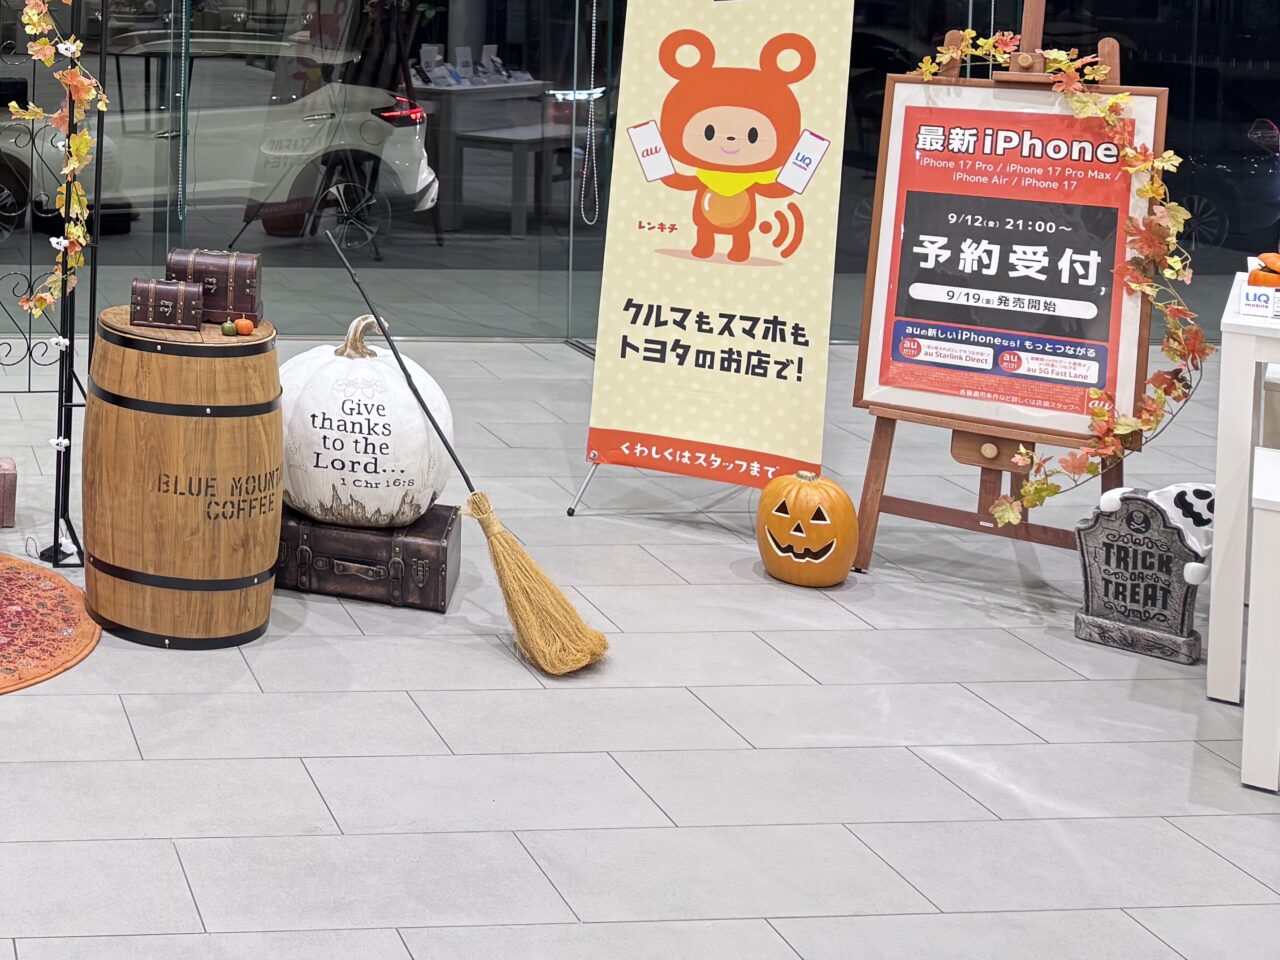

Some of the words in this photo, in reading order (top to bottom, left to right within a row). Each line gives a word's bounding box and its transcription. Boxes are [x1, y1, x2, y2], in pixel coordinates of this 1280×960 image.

[641, 145, 661, 158] au
[795, 152, 812, 168] UQ
[920, 157, 955, 168] iPhone
[959, 160, 972, 169] 17
[975, 161, 994, 172] Pro
[1006, 163, 1043, 175] iPhone
[1047, 166, 1062, 176] 17
[1065, 168, 1084, 179] Pro
[1088, 169, 1112, 180] Max
[953, 172, 989, 184] iPhone
[991, 174, 1009, 185] Air
[1021, 177, 1059, 189] iPhone
[1063, 180, 1078, 190] 17
[638, 220, 678, 233] レンキチ
[912, 234, 1102, 286] 予約受付
[1245, 292, 1270, 305] UQ
[622, 297, 810, 347] クルマもスマホも
[903, 340, 918, 349] au
[1024, 340, 1096, 358] もっとつながる
[620, 334, 804, 382] トヨタのお店で!
[935, 350, 964, 361] Starlink
[965, 356, 988, 365] Direct
[1003, 353, 1018, 362] au
[1038, 367, 1049, 375] 5G
[1051, 369, 1067, 377] Fast
[1069, 371, 1089, 380] Lane
[341, 398, 387, 417] Give
[1088, 399, 1114, 410] au
[310, 411, 392, 437] thanks
[322, 435, 345, 452] to
[353, 436, 390, 456] the
[620, 442, 780, 479] くわしくはスタッフまで
[157, 472, 217, 497] BLUE
[230, 466, 281, 497] MOUNT
[340, 477, 347, 486] 1
[352, 479, 381, 489] Chr
[206, 492, 275, 521] COFFEE
[1102, 541, 1173, 578] TRICK
[1129, 571, 1145, 583] OR
[1102, 576, 1172, 611] TREAT
